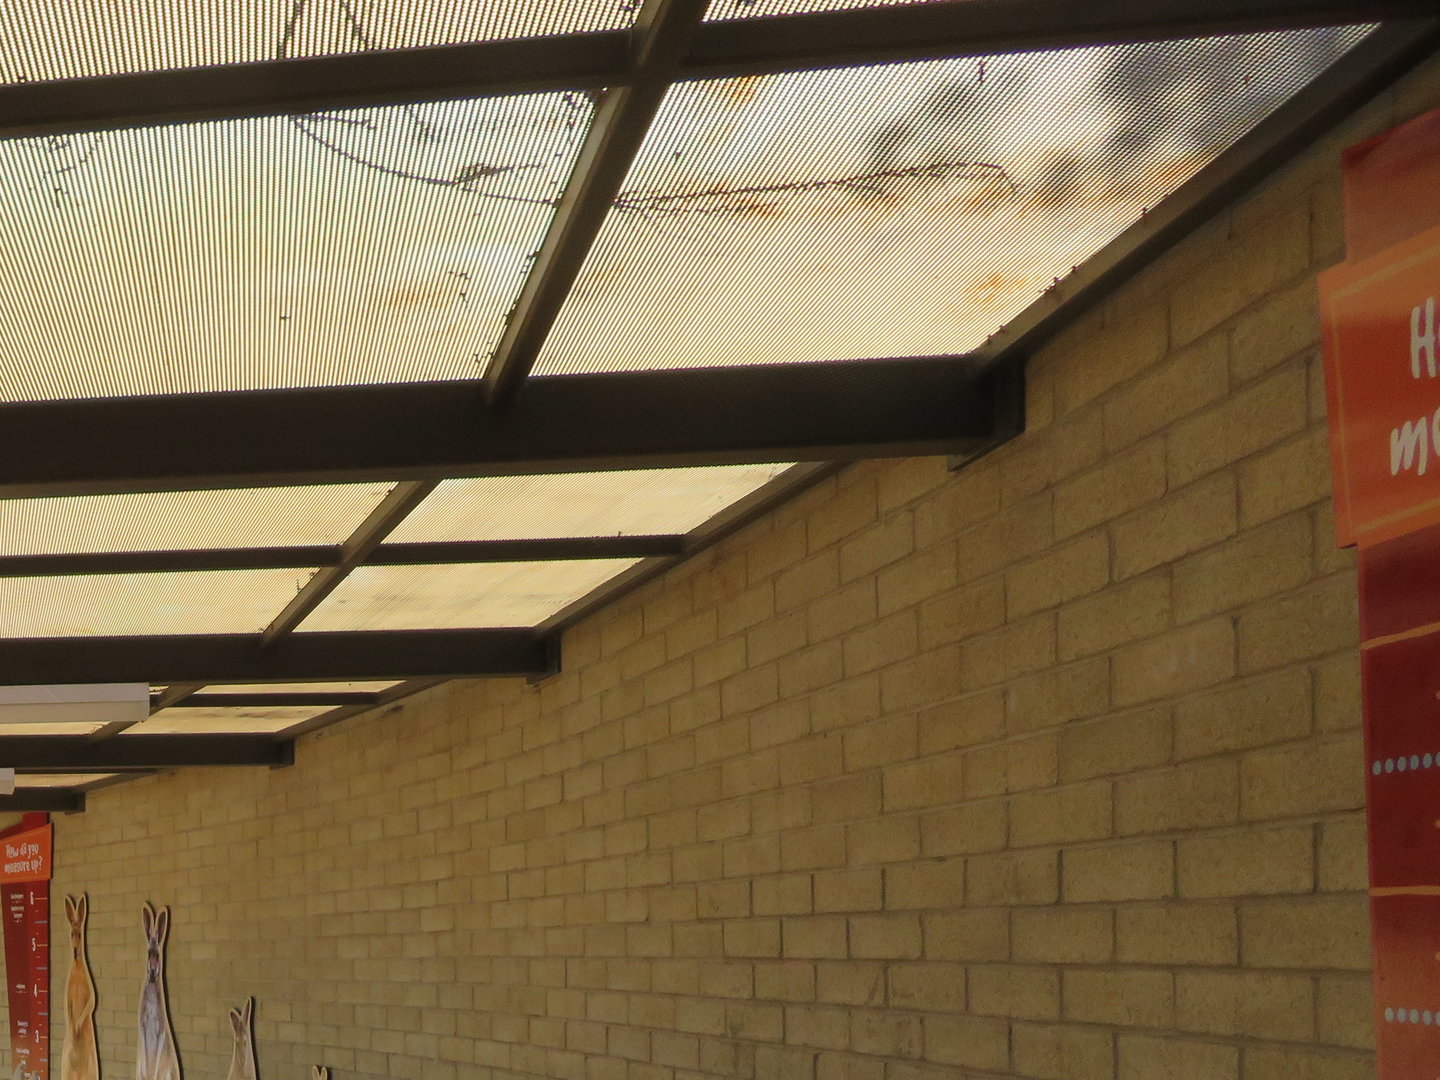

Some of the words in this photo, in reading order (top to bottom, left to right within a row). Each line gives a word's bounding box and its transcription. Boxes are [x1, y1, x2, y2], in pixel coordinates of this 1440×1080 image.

[1411, 296, 1440, 379] H
[6, 844, 19, 858] How
[20, 842, 27, 856] do
[28, 843, 39, 859] you
[4, 861, 30, 874] measure
[31, 855, 43, 874] up?
